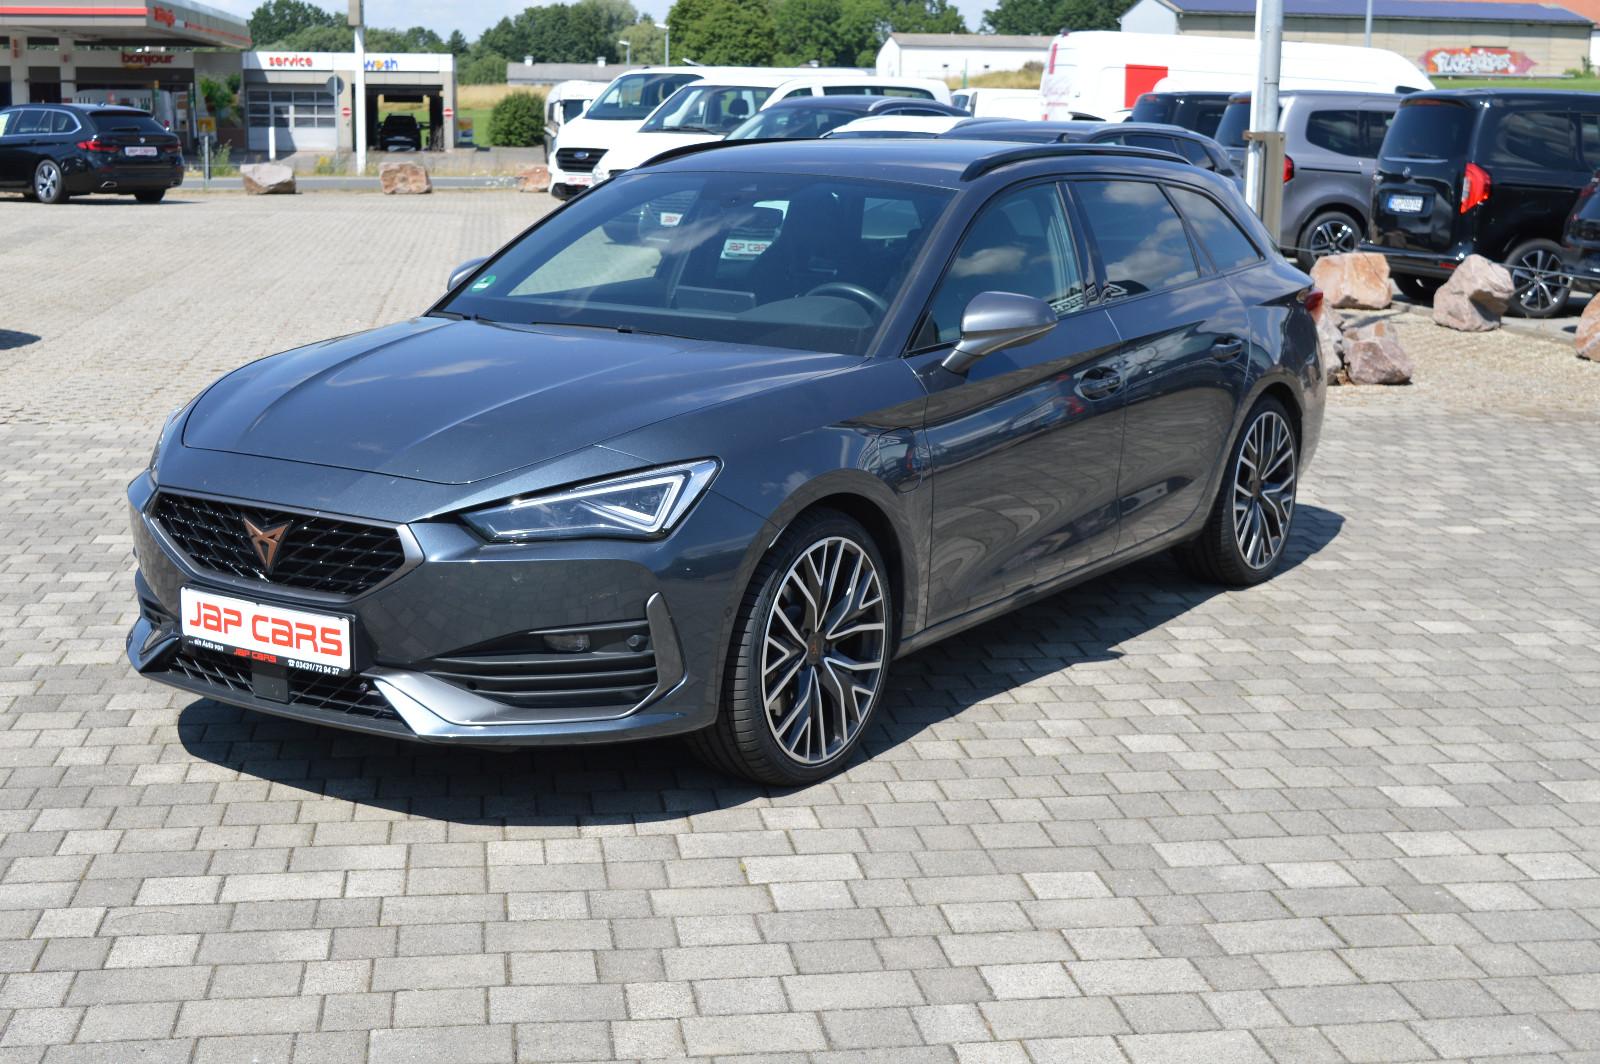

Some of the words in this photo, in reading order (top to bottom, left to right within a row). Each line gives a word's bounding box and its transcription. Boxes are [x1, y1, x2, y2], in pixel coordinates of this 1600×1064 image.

[121, 52, 176, 66] bonjour
[268, 55, 313, 67] service
[202, 640, 214, 650] Auto
[214, 643, 224, 652] von
